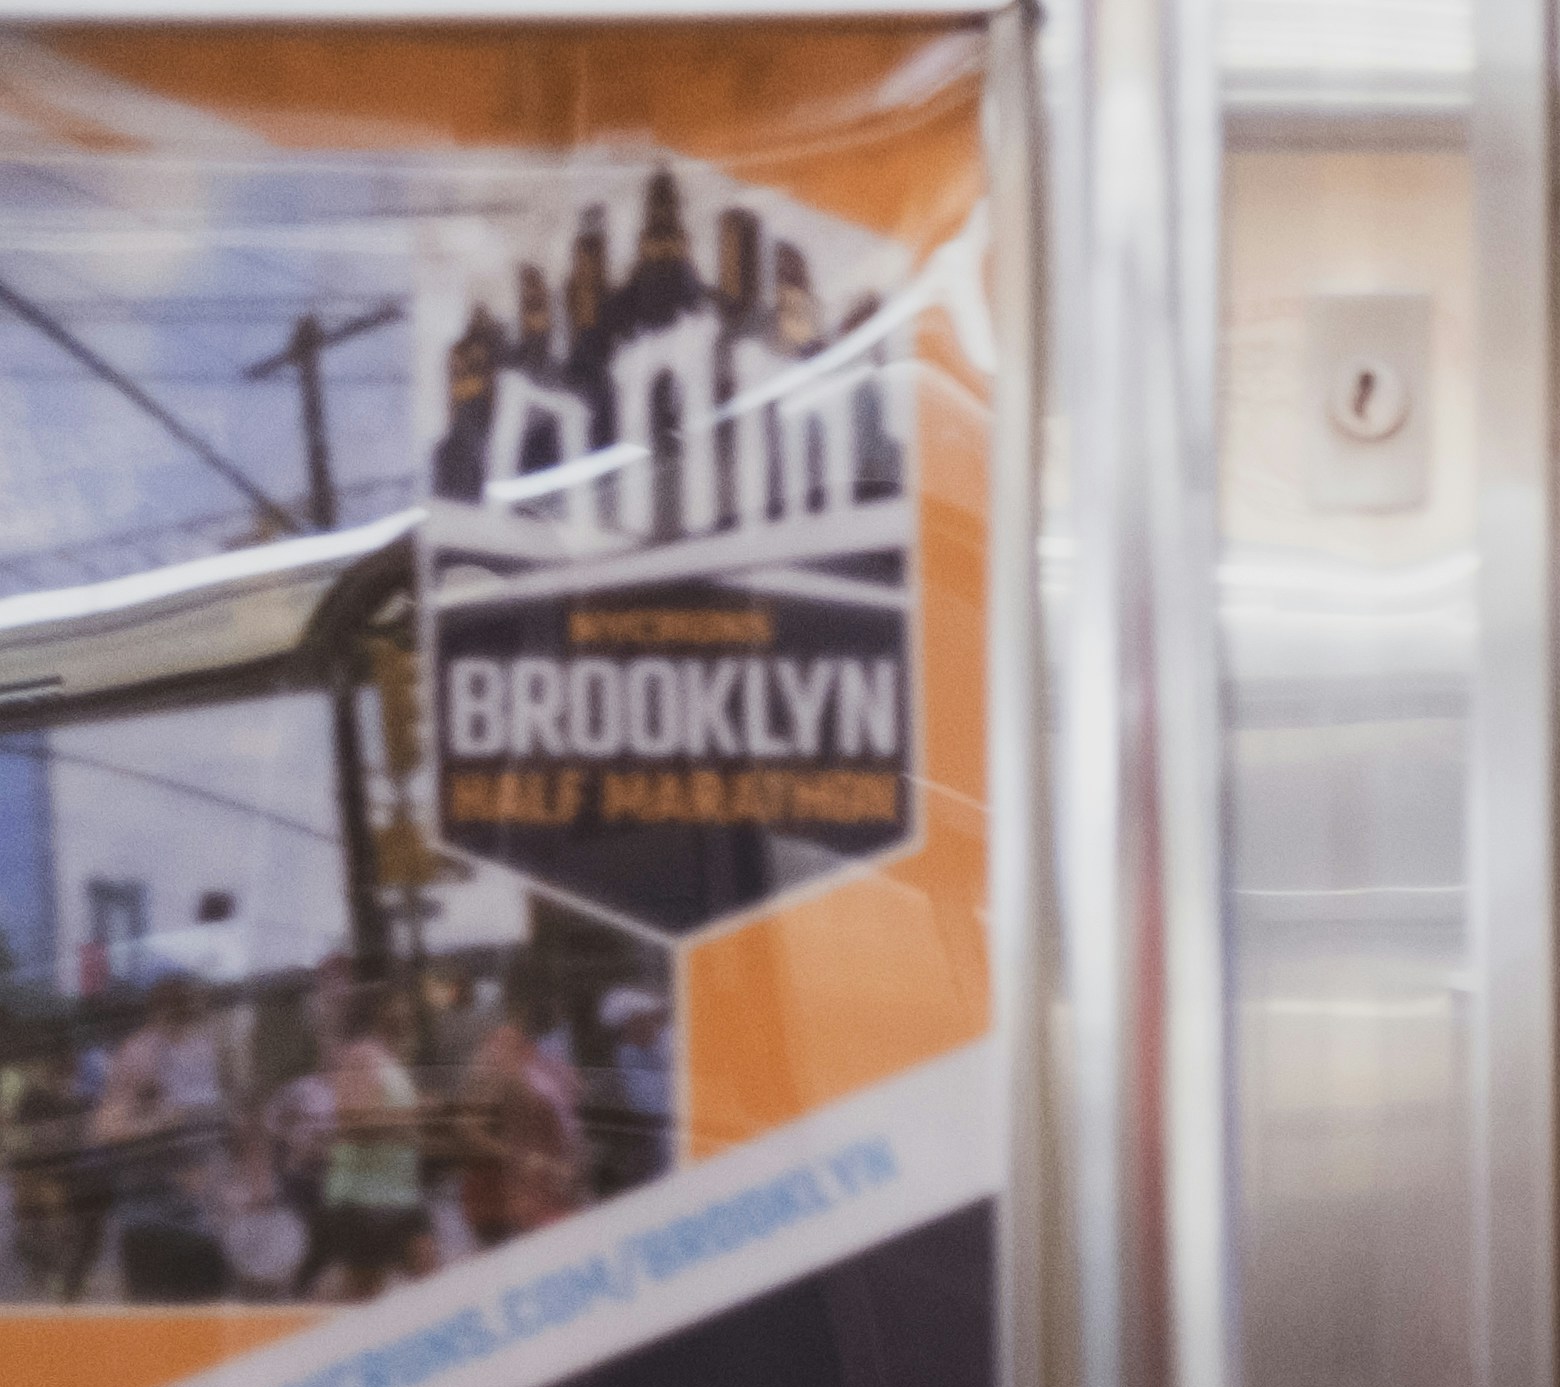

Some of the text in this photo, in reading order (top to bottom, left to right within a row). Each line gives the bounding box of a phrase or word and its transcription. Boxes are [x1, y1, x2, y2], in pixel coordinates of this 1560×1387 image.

[450, 656, 899, 759] BROOKLYN
[450, 769, 899, 823] HALF MARATHON
